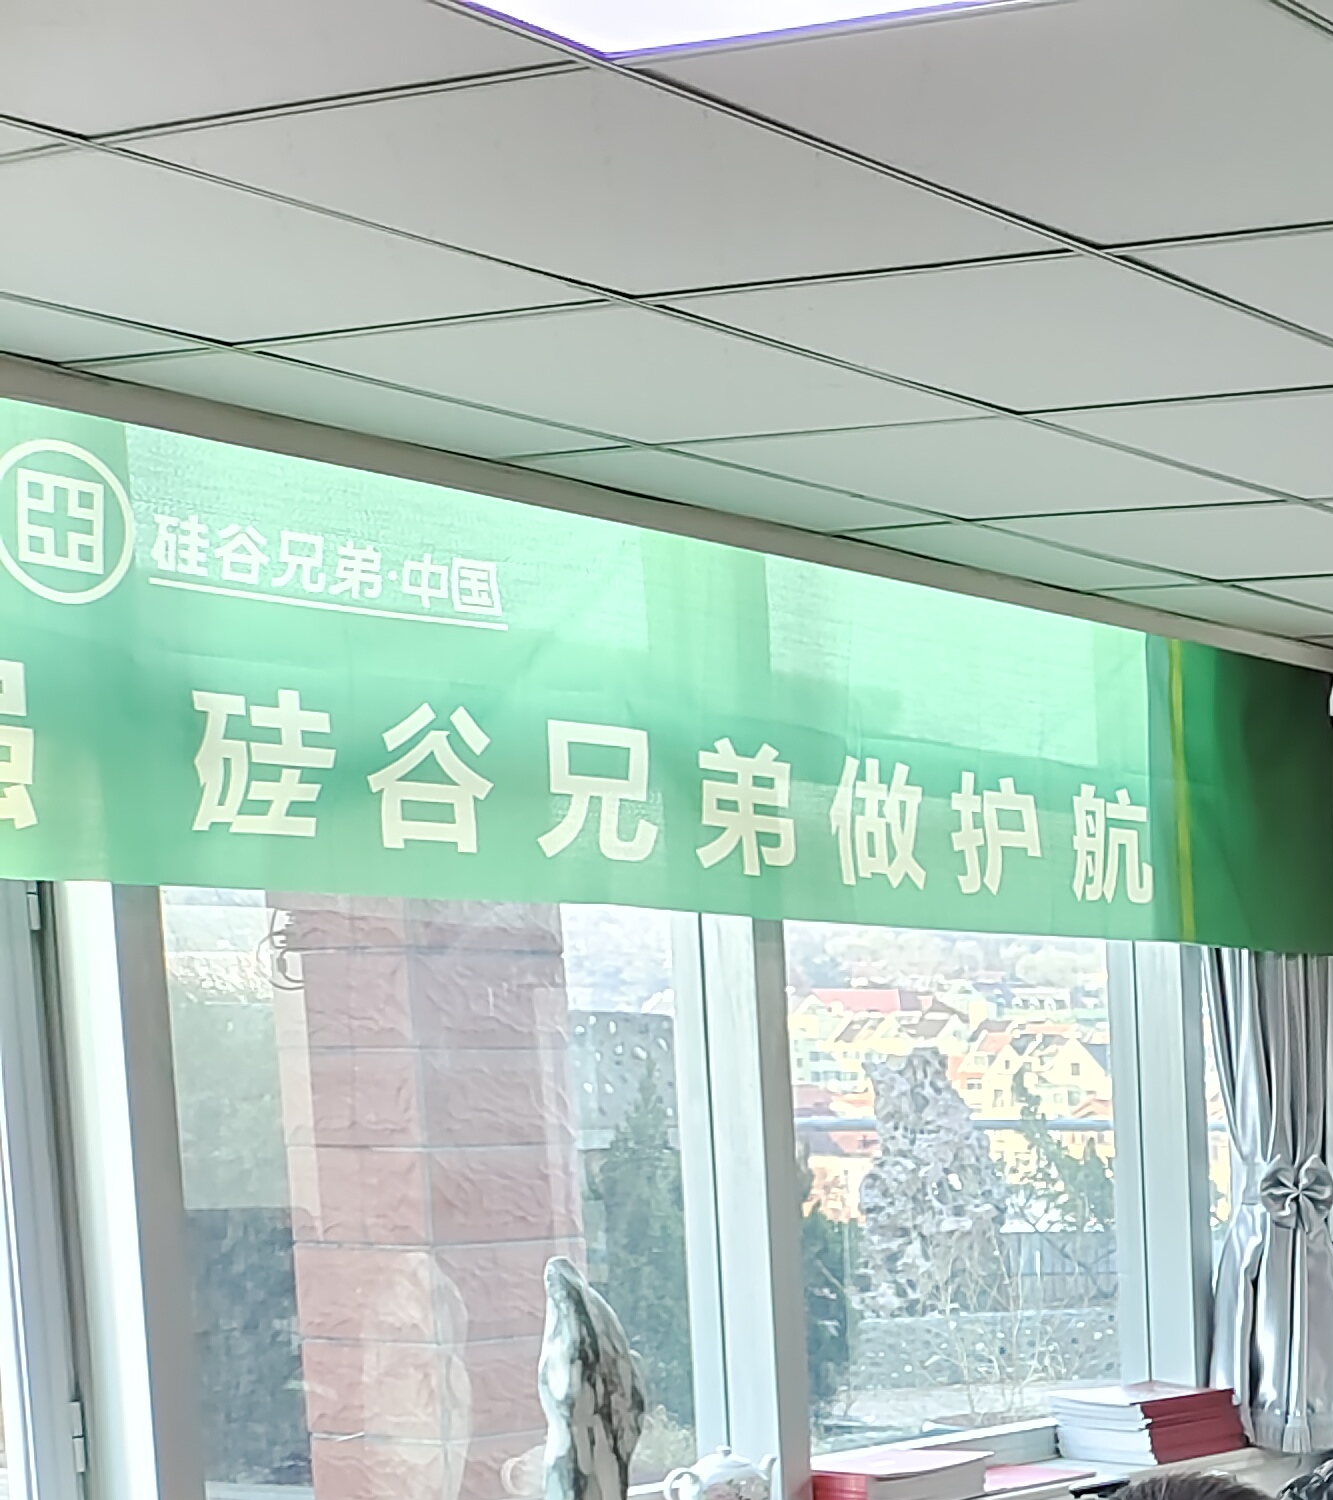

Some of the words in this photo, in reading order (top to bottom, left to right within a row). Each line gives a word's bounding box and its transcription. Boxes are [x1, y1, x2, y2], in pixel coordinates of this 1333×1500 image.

[191, 688, 1154, 904] 硅谷兄弟做护航
